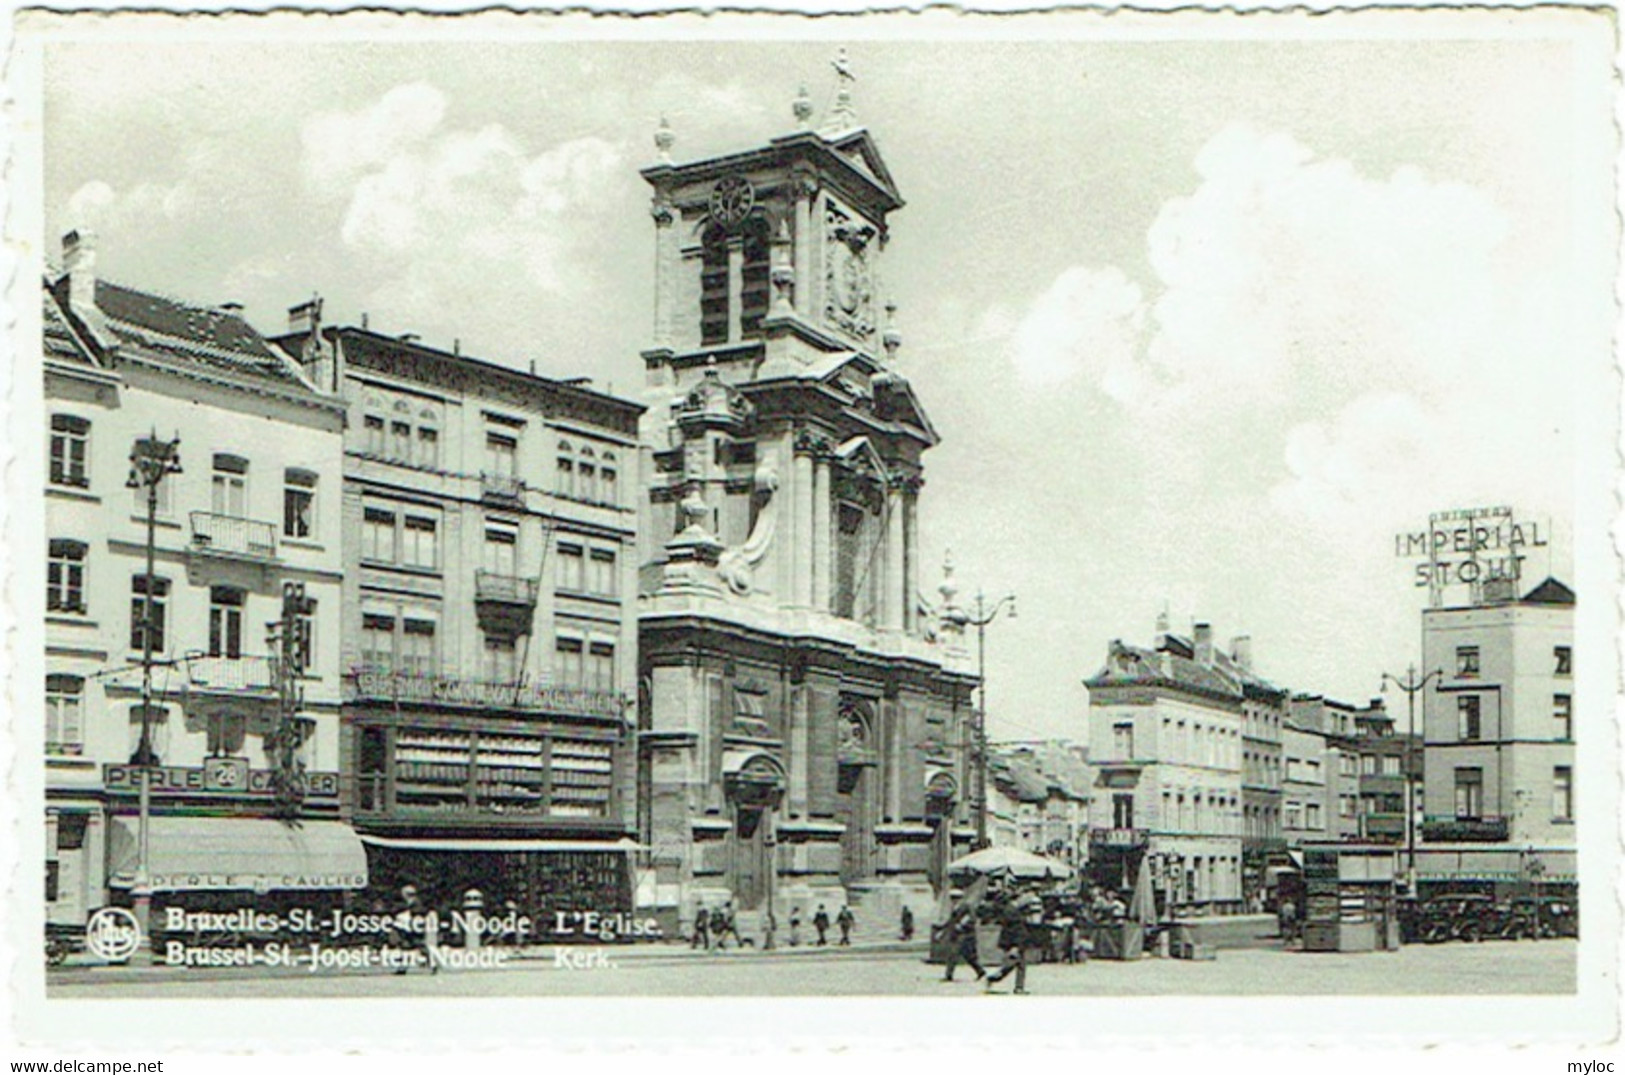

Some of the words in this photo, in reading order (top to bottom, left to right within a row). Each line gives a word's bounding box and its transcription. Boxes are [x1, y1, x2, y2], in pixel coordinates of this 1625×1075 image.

[1395, 522, 1548, 557] IMPERIAL
[1415, 555, 1527, 587] STOUT
[108, 768, 201, 787] PERLE
